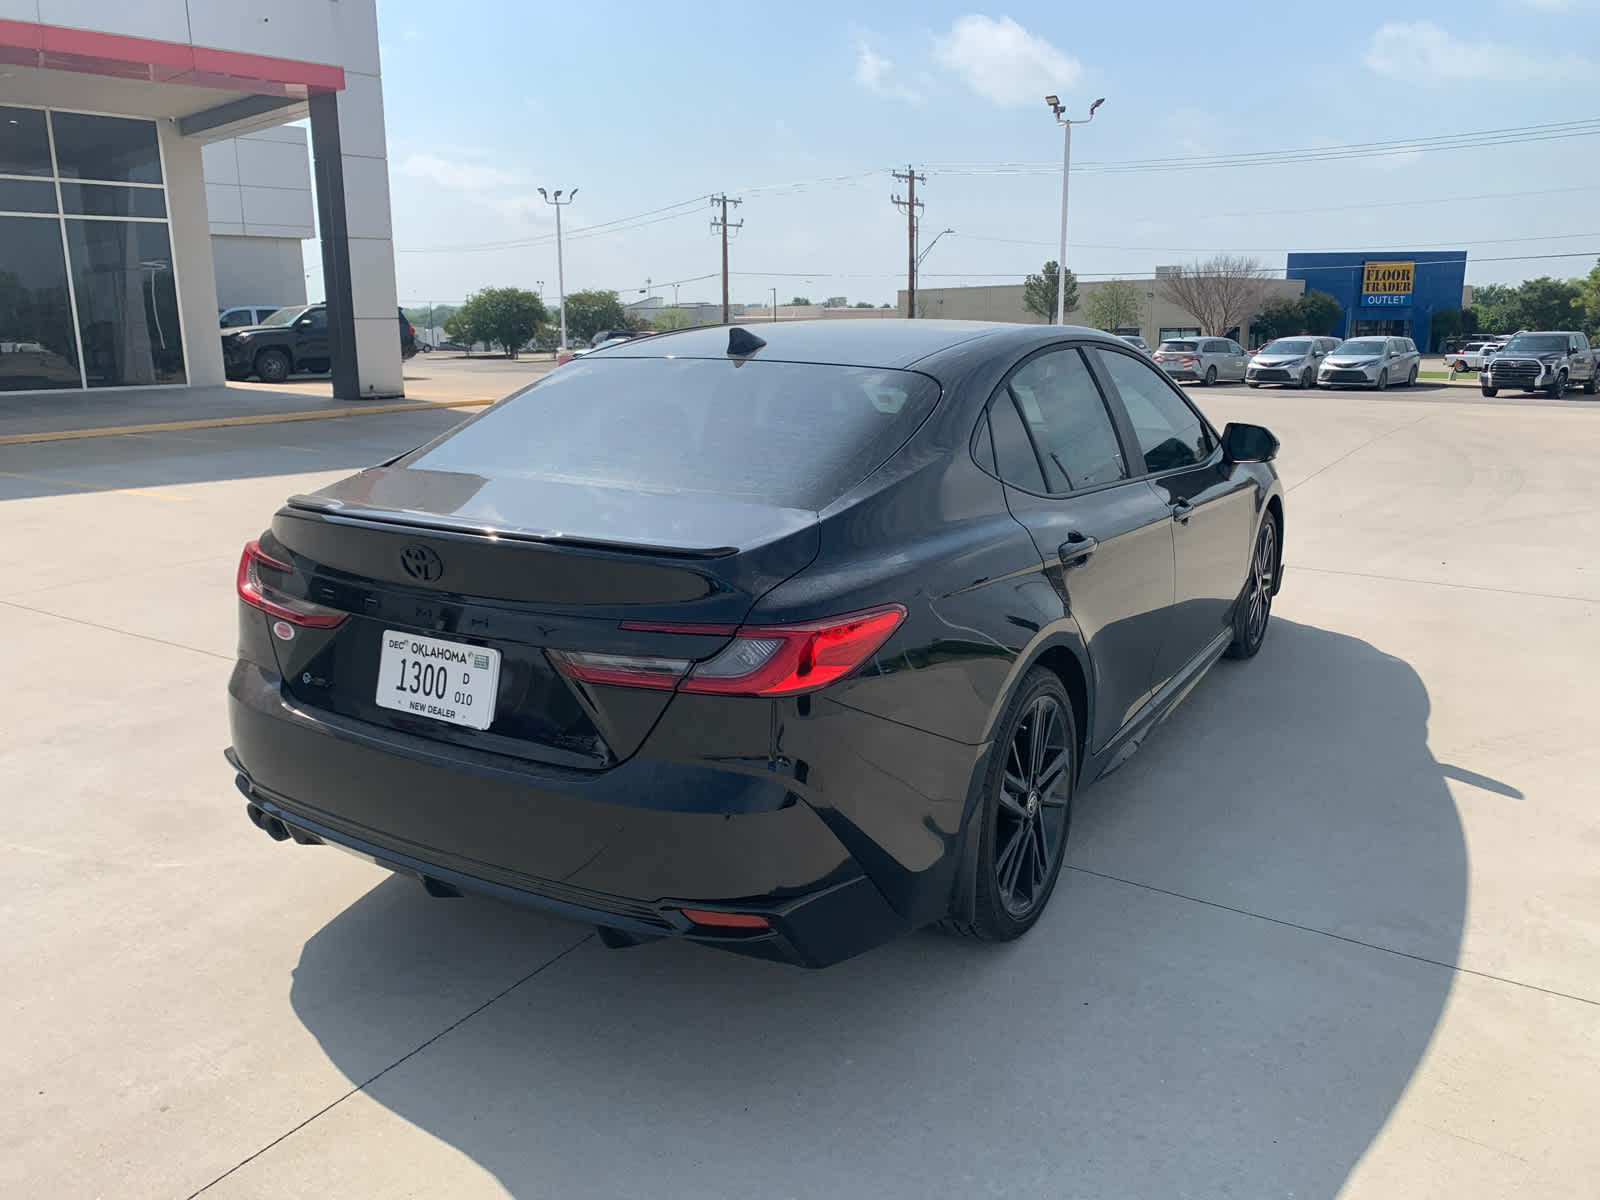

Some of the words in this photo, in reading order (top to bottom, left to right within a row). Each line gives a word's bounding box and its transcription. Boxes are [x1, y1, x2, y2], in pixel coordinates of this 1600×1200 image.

[1367, 269, 1410, 281] FLOOR
[1366, 282, 1410, 292] TRADER
[1368, 296, 1406, 304] OUTLET
[388, 639, 404, 650] DEC
[411, 642, 467, 664] OKLAHOMA
[396, 659, 448, 699] 1300
[462, 673, 470, 684] D
[454, 691, 473, 706] 010
[410, 702, 427, 712] NEW
[427, 705, 456, 719] DEALER
